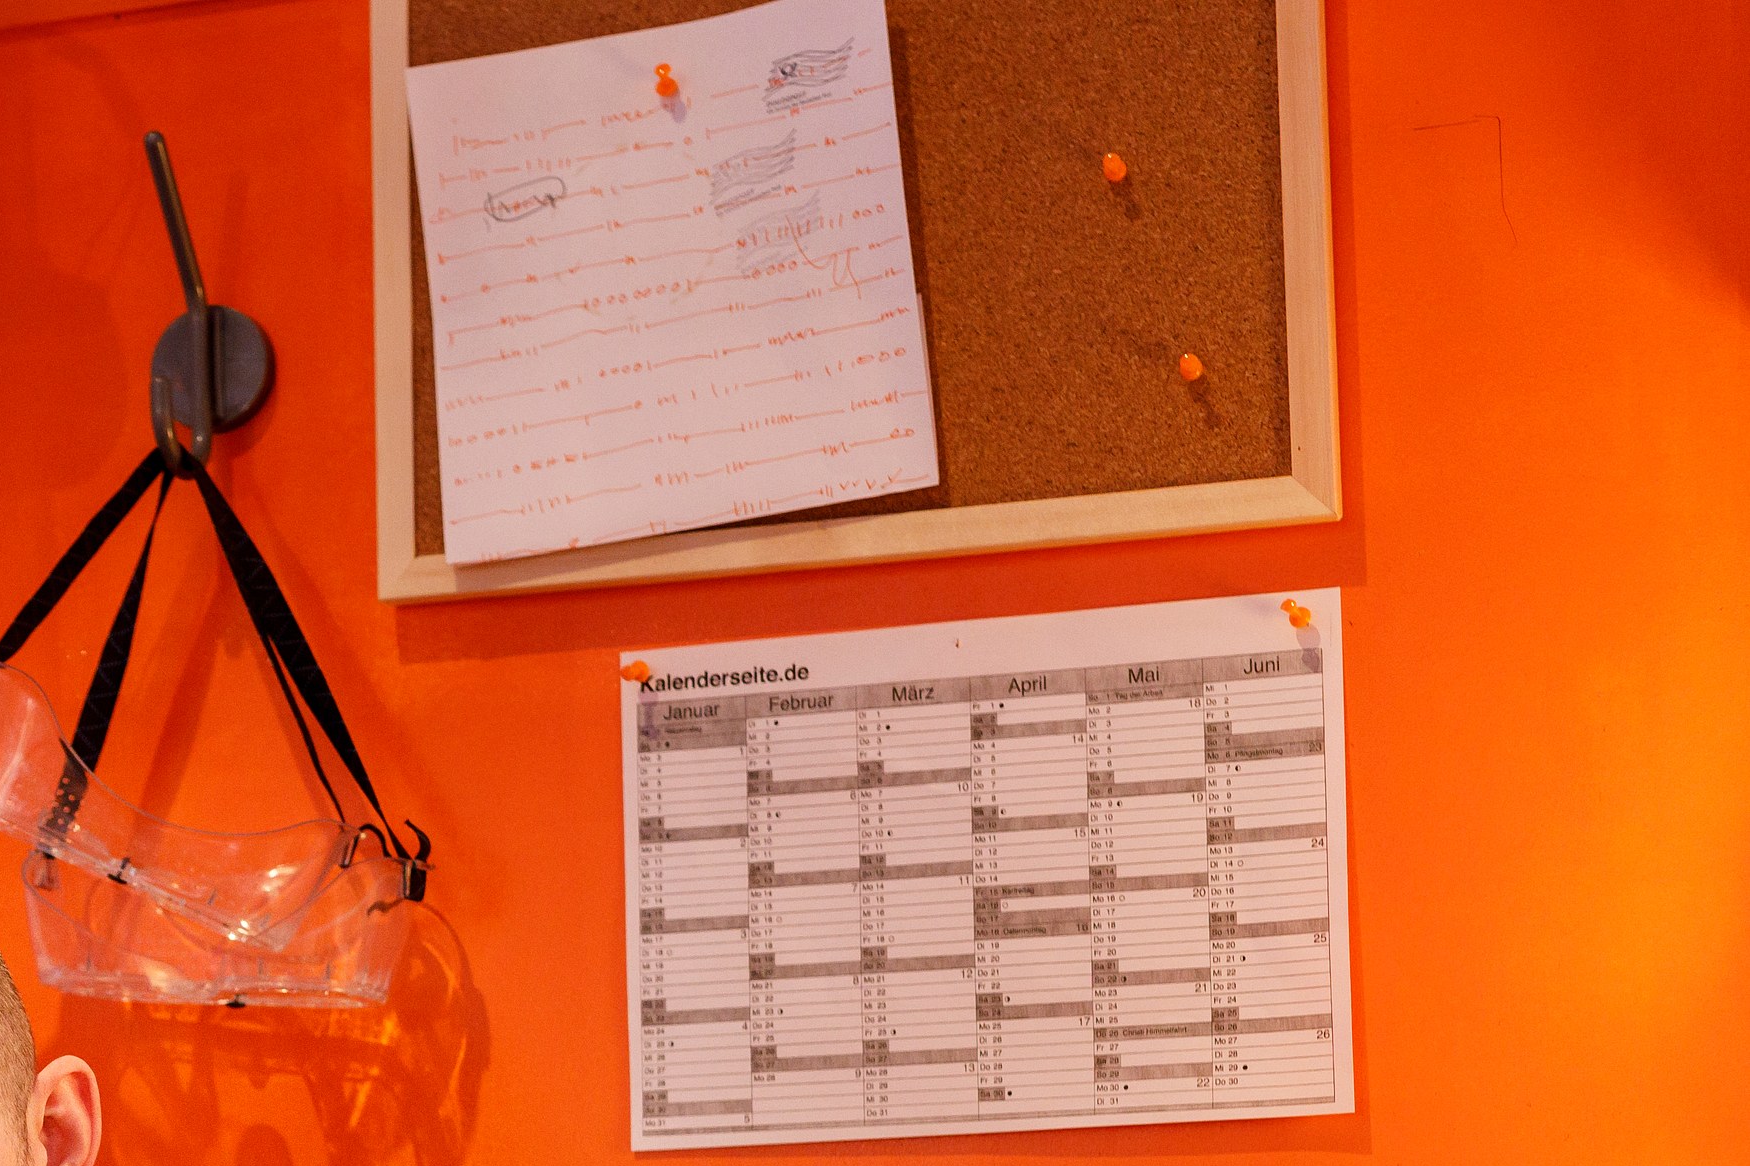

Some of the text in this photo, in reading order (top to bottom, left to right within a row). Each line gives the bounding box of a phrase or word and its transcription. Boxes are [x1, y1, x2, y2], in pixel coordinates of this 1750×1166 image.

[640, 664, 810, 693] Kalenderseite.de
[663, 656, 1280, 721] Januar Februar März April Mai Juni
[1189, 698, 1201, 708] 18
[1073, 735, 1084, 745] 14
[958, 783, 969, 792] 10
[1191, 793, 1204, 803] 19
[1074, 828, 1086, 838] 15
[1311, 838, 1325, 849] 24
[959, 876, 970, 886] 11
[1193, 887, 1206, 898] 20
[1313, 933, 1327, 943] 25
[961, 969, 973, 979] 12
[1195, 983, 1208, 993] 21
[1079, 1016, 1090, 1026] 17
[1316, 1030, 1330, 1040] 26
[963, 1063, 975, 1073] 13
[1197, 1077, 1210, 1088] 22
